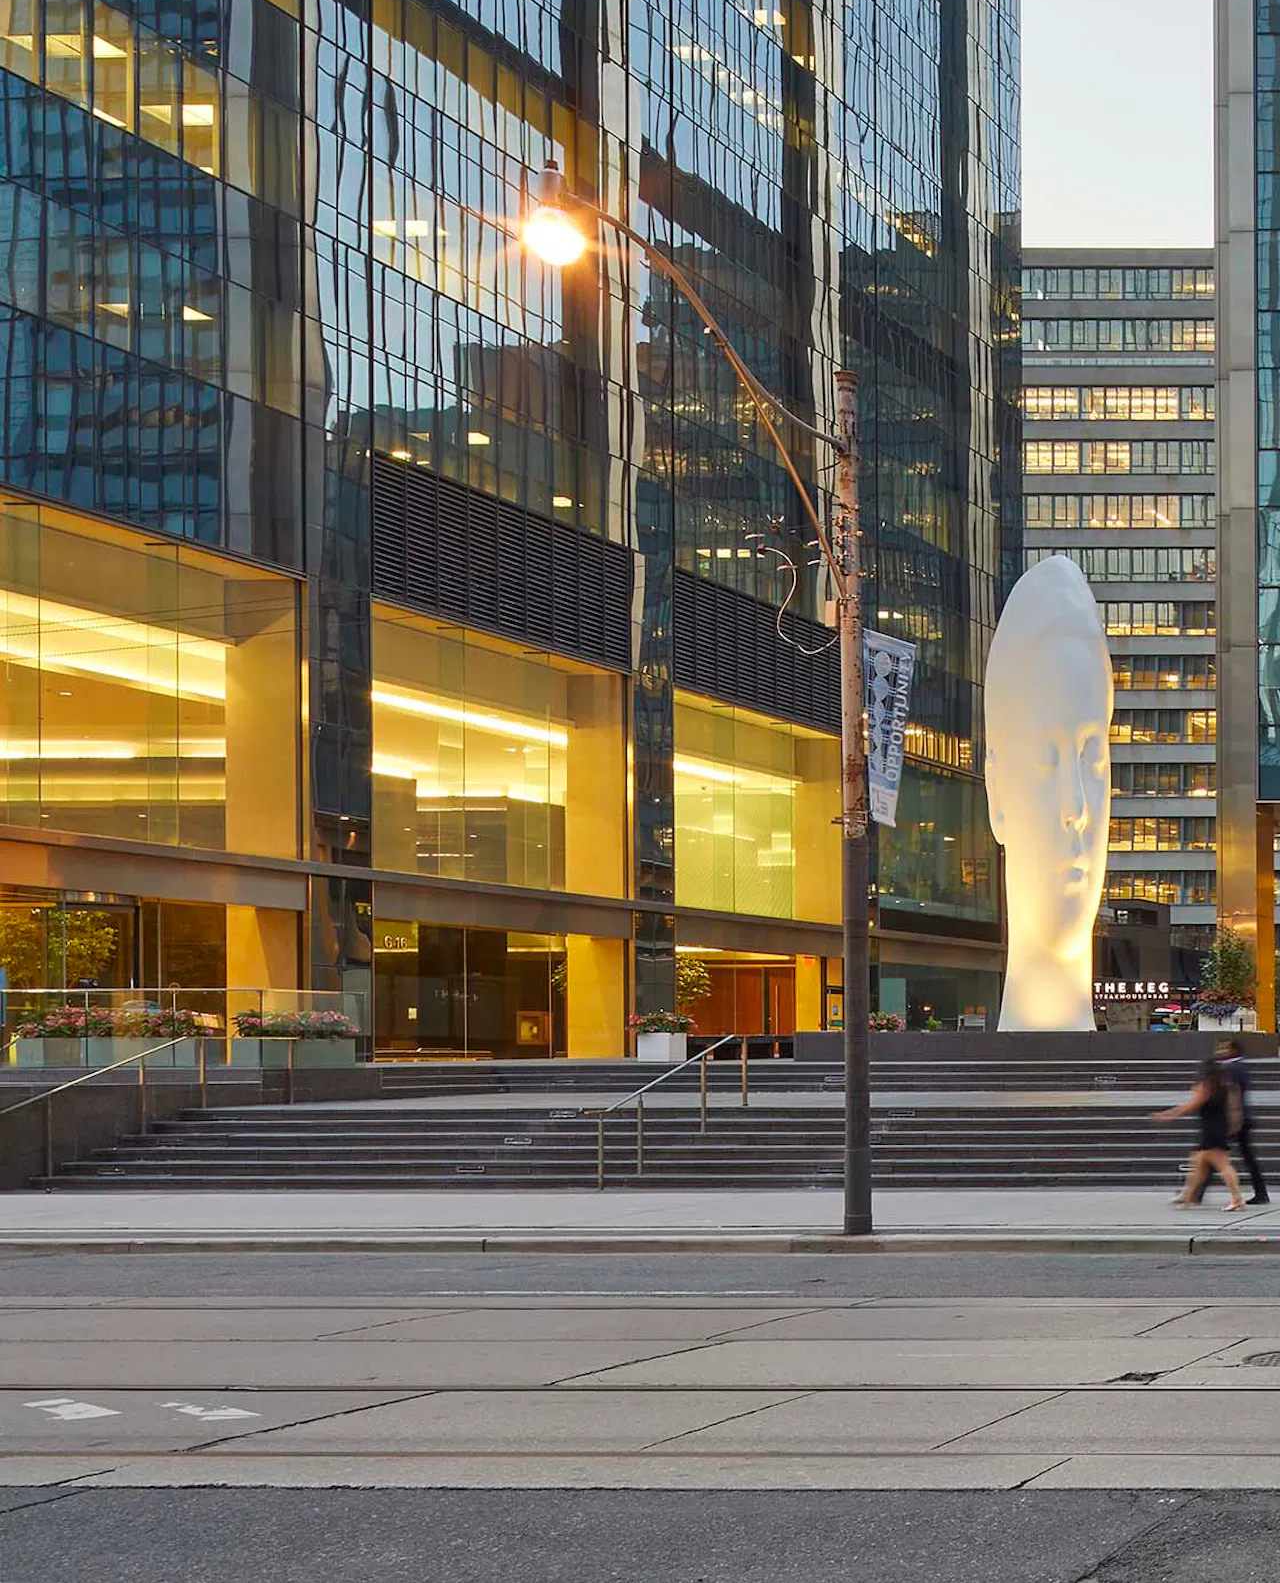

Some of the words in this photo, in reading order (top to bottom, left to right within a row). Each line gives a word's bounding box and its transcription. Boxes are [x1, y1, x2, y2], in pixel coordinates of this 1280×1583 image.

[886, 650, 912, 781] OPPORTUNITY
[1093, 982, 1127, 993] THE
[1134, 982, 1169, 993] KEG
